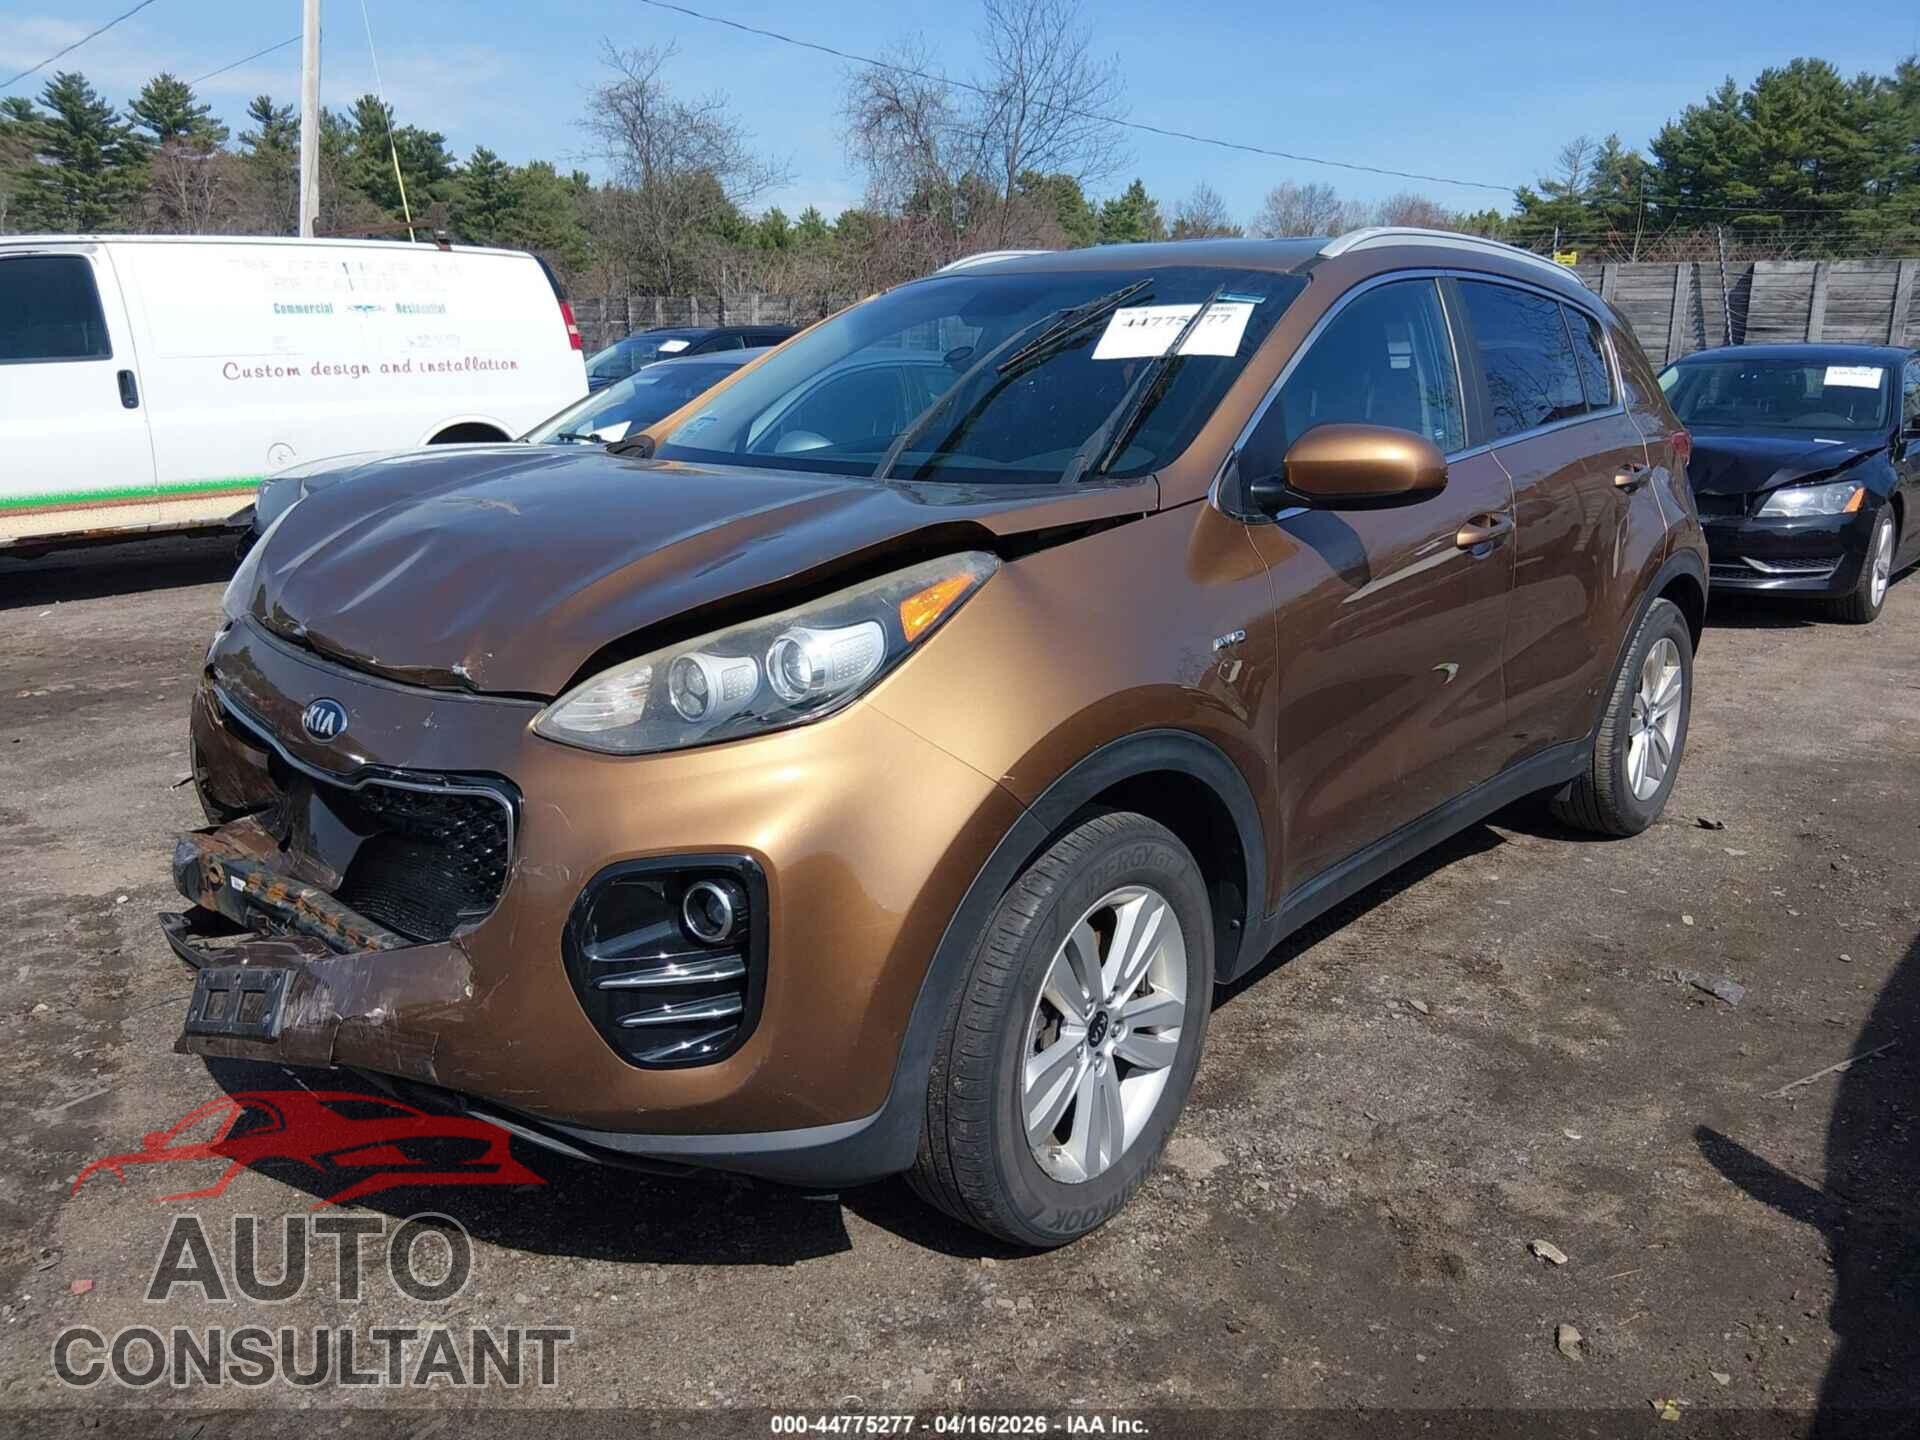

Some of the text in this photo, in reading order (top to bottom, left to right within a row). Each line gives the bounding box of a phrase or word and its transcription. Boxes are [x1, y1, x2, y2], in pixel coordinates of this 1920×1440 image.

[273, 302, 334, 314] Commercial
[1122, 314, 1232, 328] 4477577
[222, 356, 519, 381] Custom design and installation
[306, 705, 336, 736] KIA
